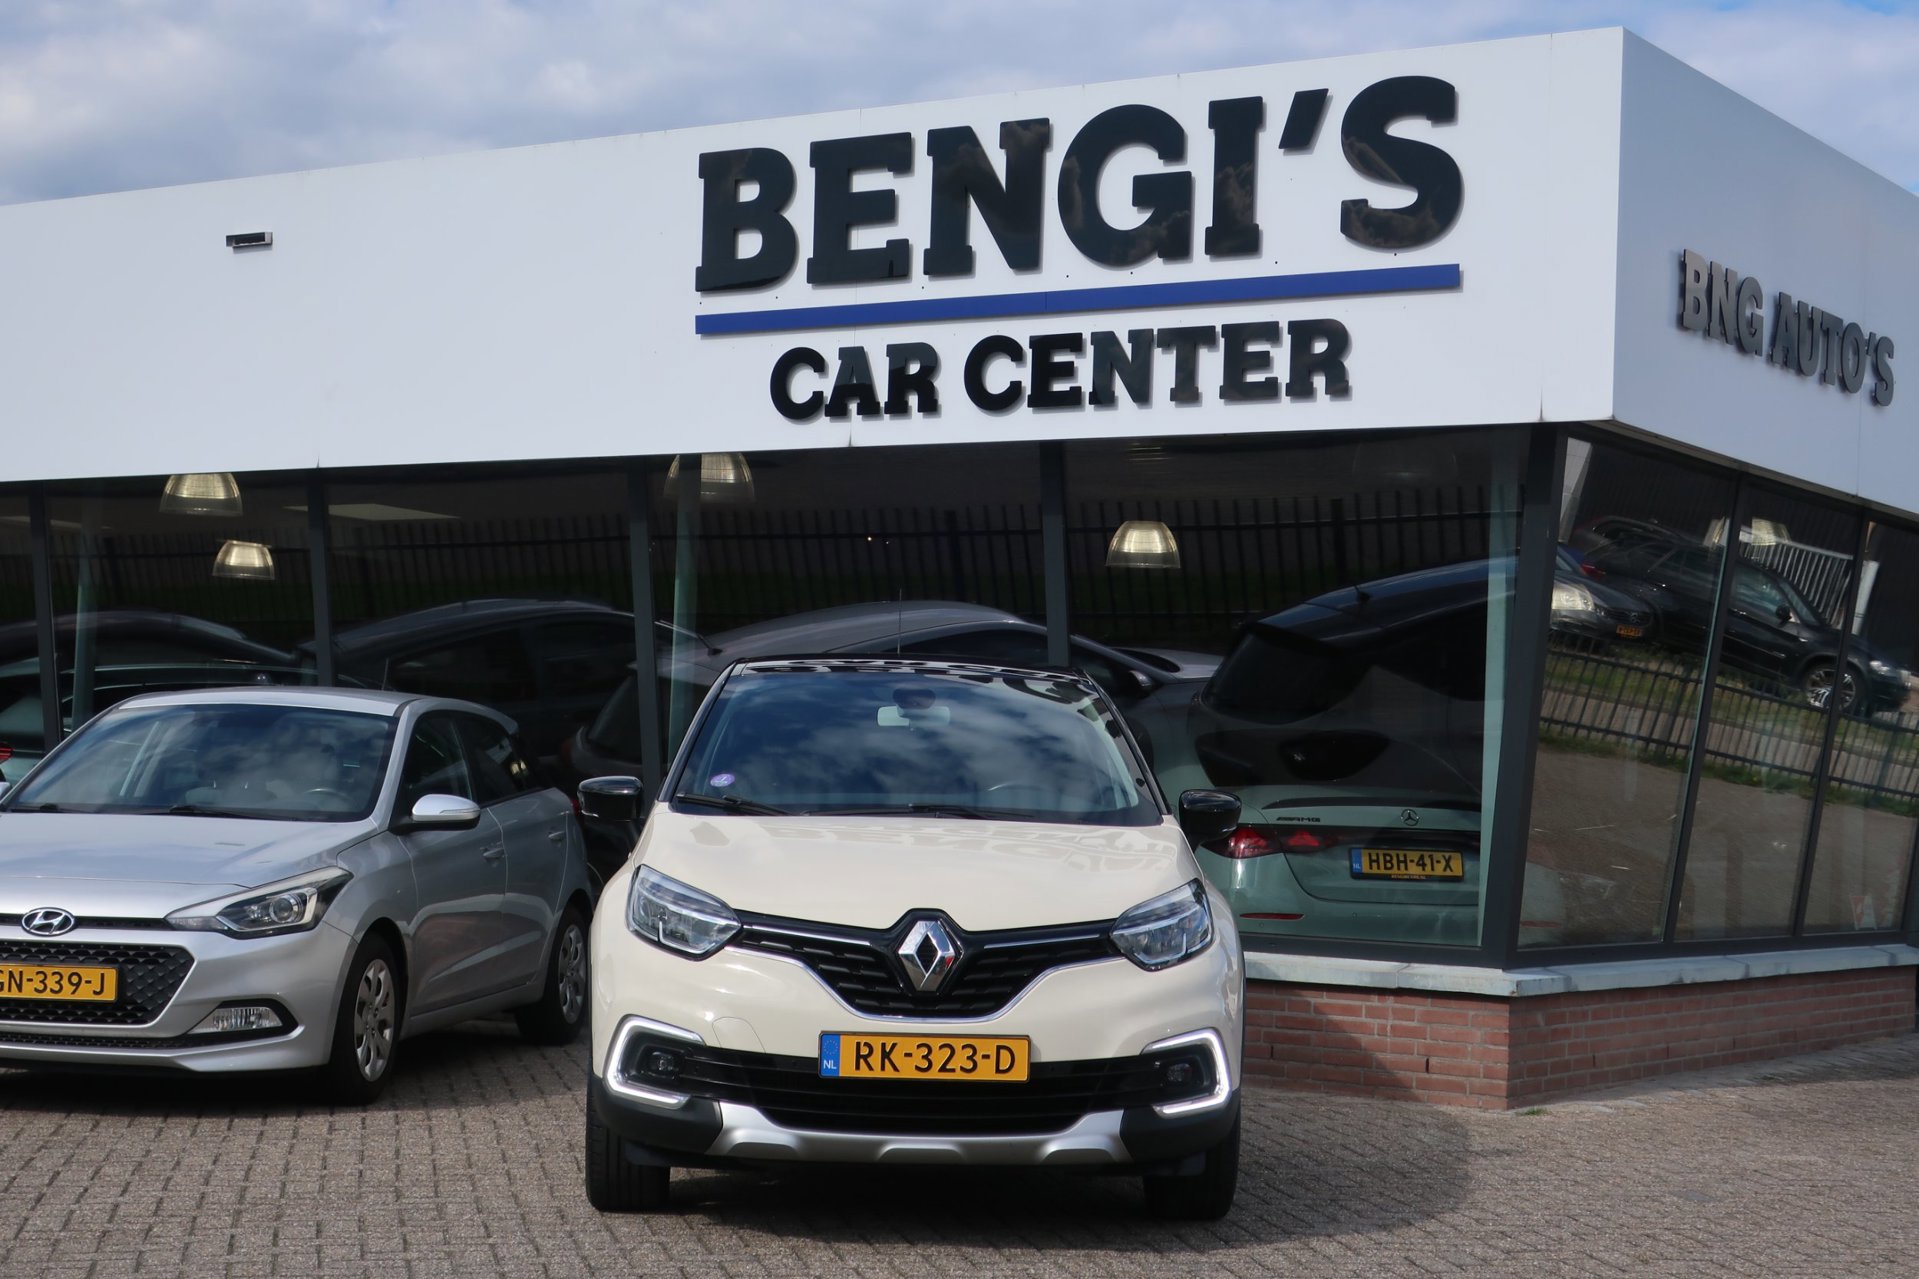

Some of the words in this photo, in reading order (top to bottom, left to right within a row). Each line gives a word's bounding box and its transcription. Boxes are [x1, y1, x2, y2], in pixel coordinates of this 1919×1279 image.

[695, 75, 1464, 292] BENGI'S
[770, 341, 941, 420] CAR
[963, 318, 1353, 411] CENTER
[1682, 249, 1763, 356] BNG
[1772, 292, 1894, 406] AUTO'S
[1368, 852, 1454, 873] HBH-41-X
[823, 1060, 837, 1070] NL
[854, 1041, 1016, 1074] RK-323-D
